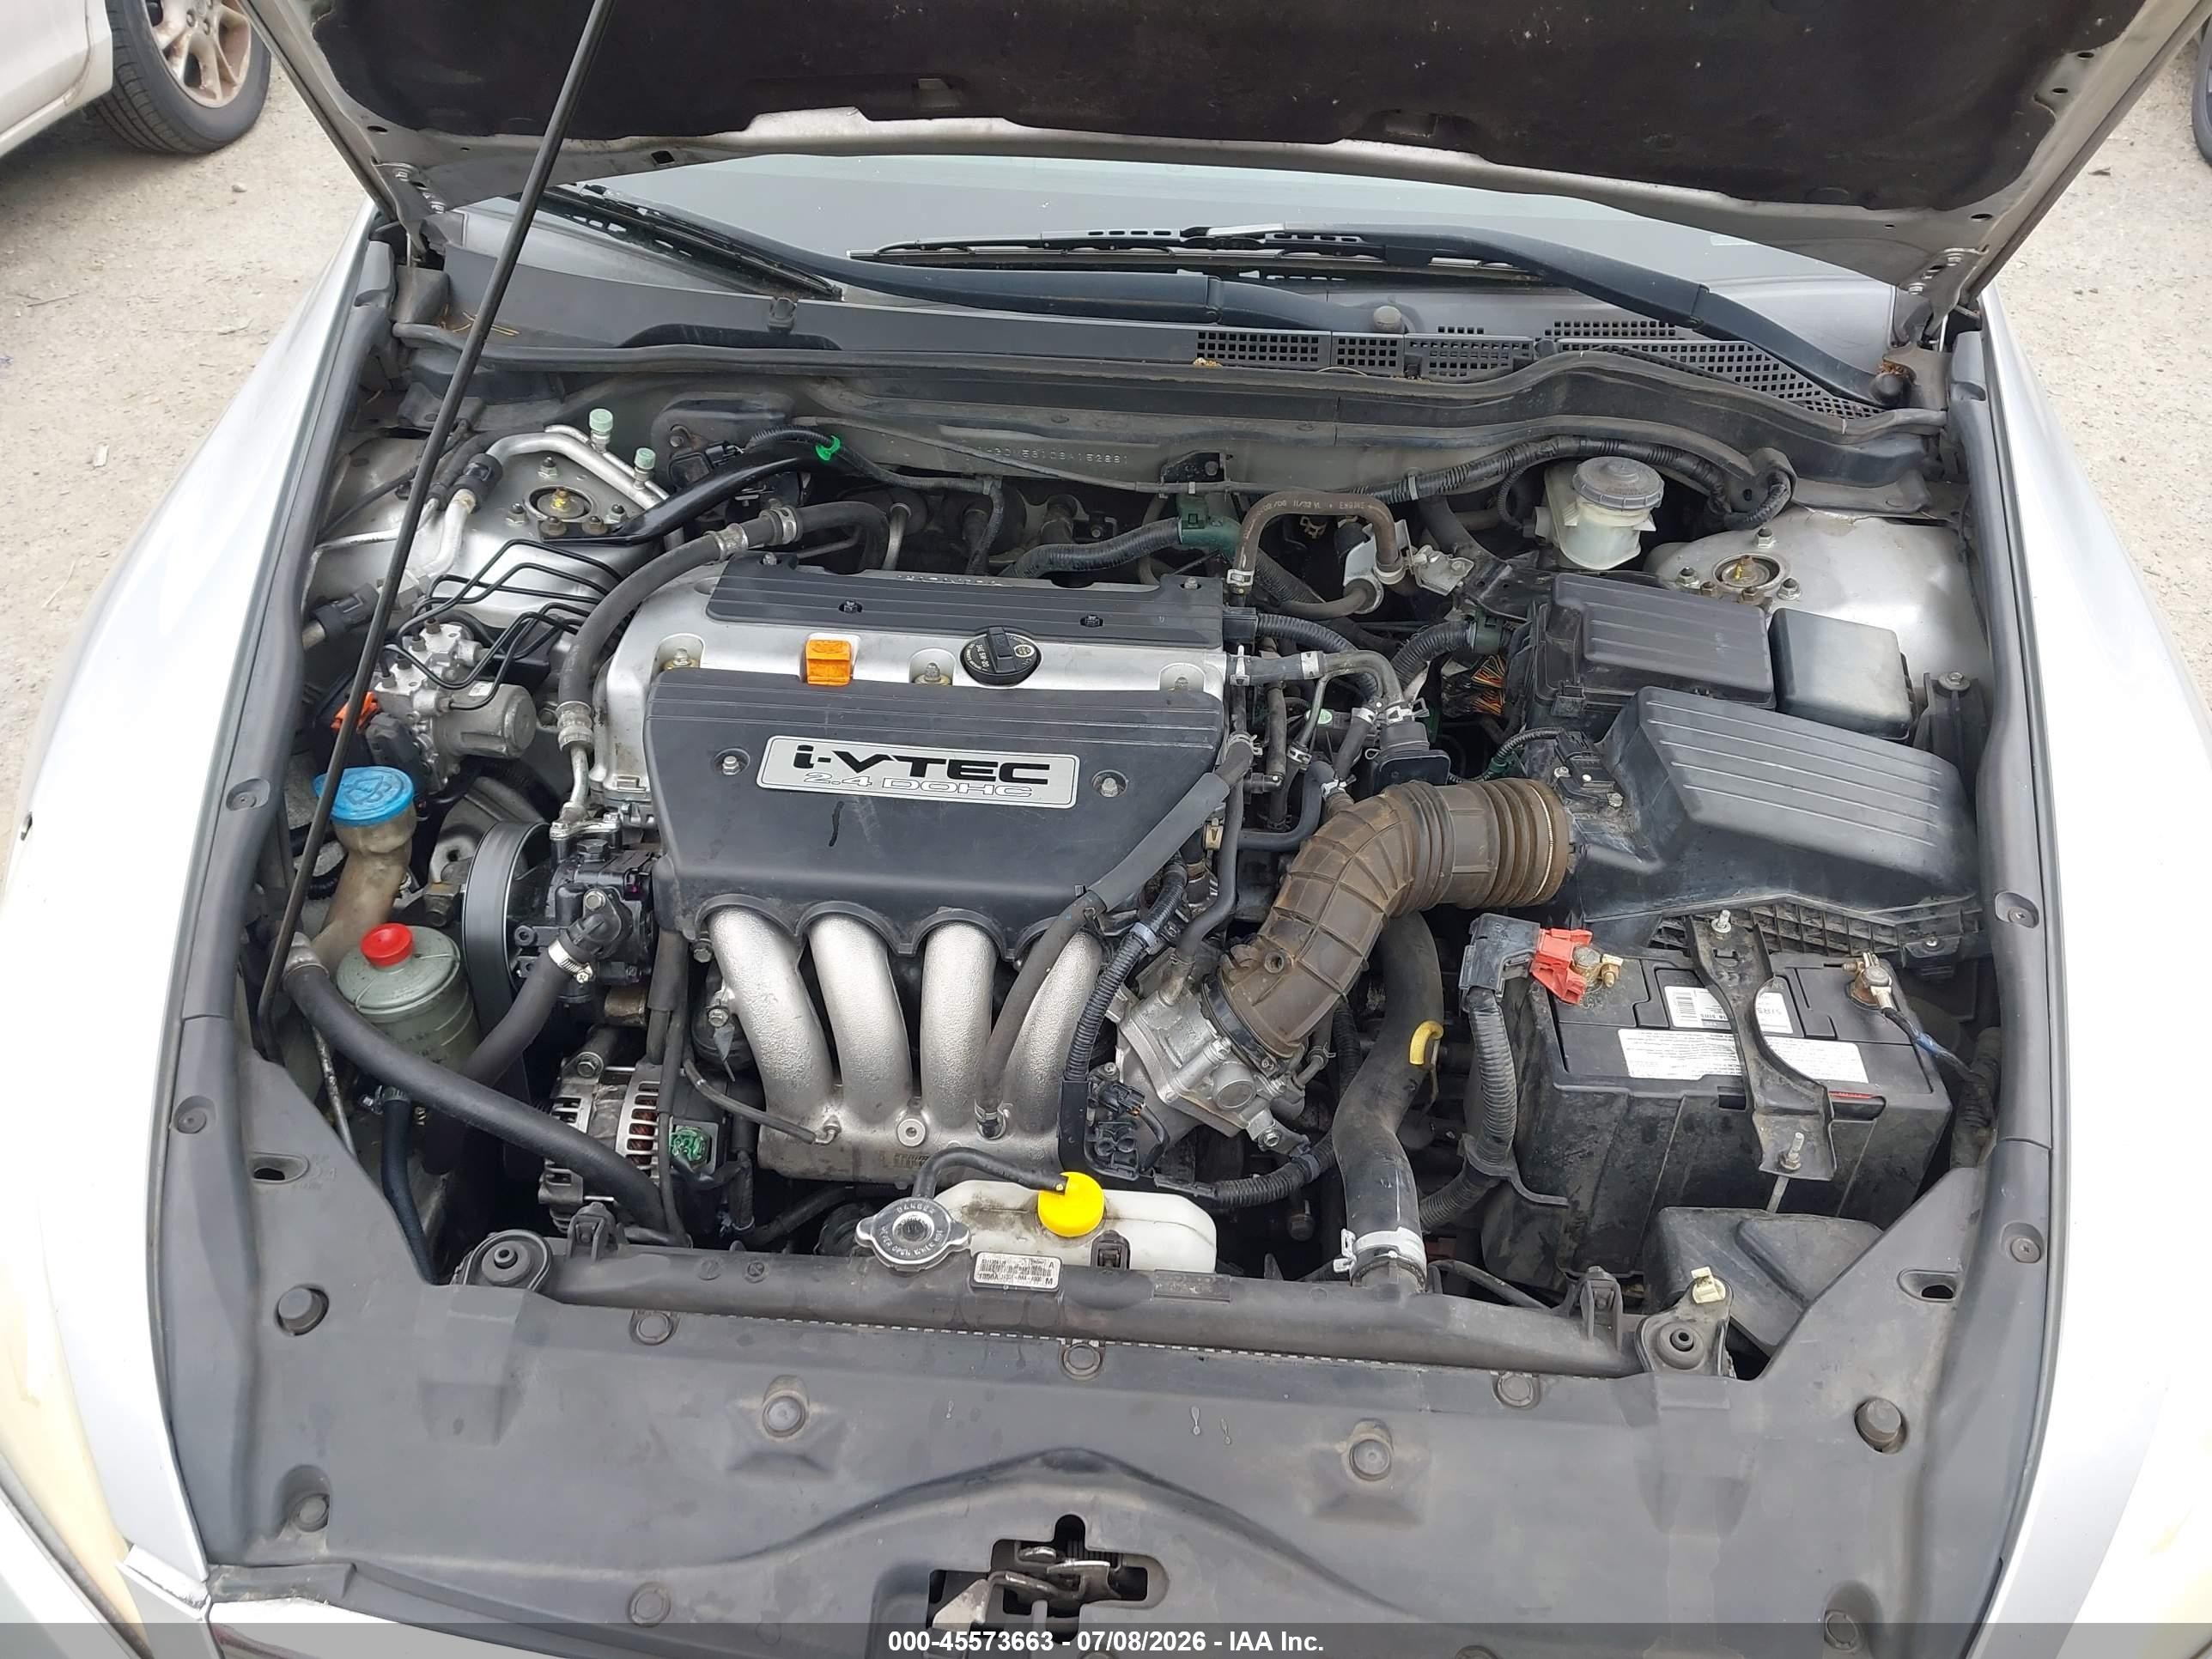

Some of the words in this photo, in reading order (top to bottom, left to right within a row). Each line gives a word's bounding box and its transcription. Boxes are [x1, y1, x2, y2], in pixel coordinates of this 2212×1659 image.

[793, 744, 1050, 785] i-VTEC
[804, 771, 873, 788] 2.4
[882, 777, 1032, 797] DOHC
[1044, 1277, 1054, 1285] M
